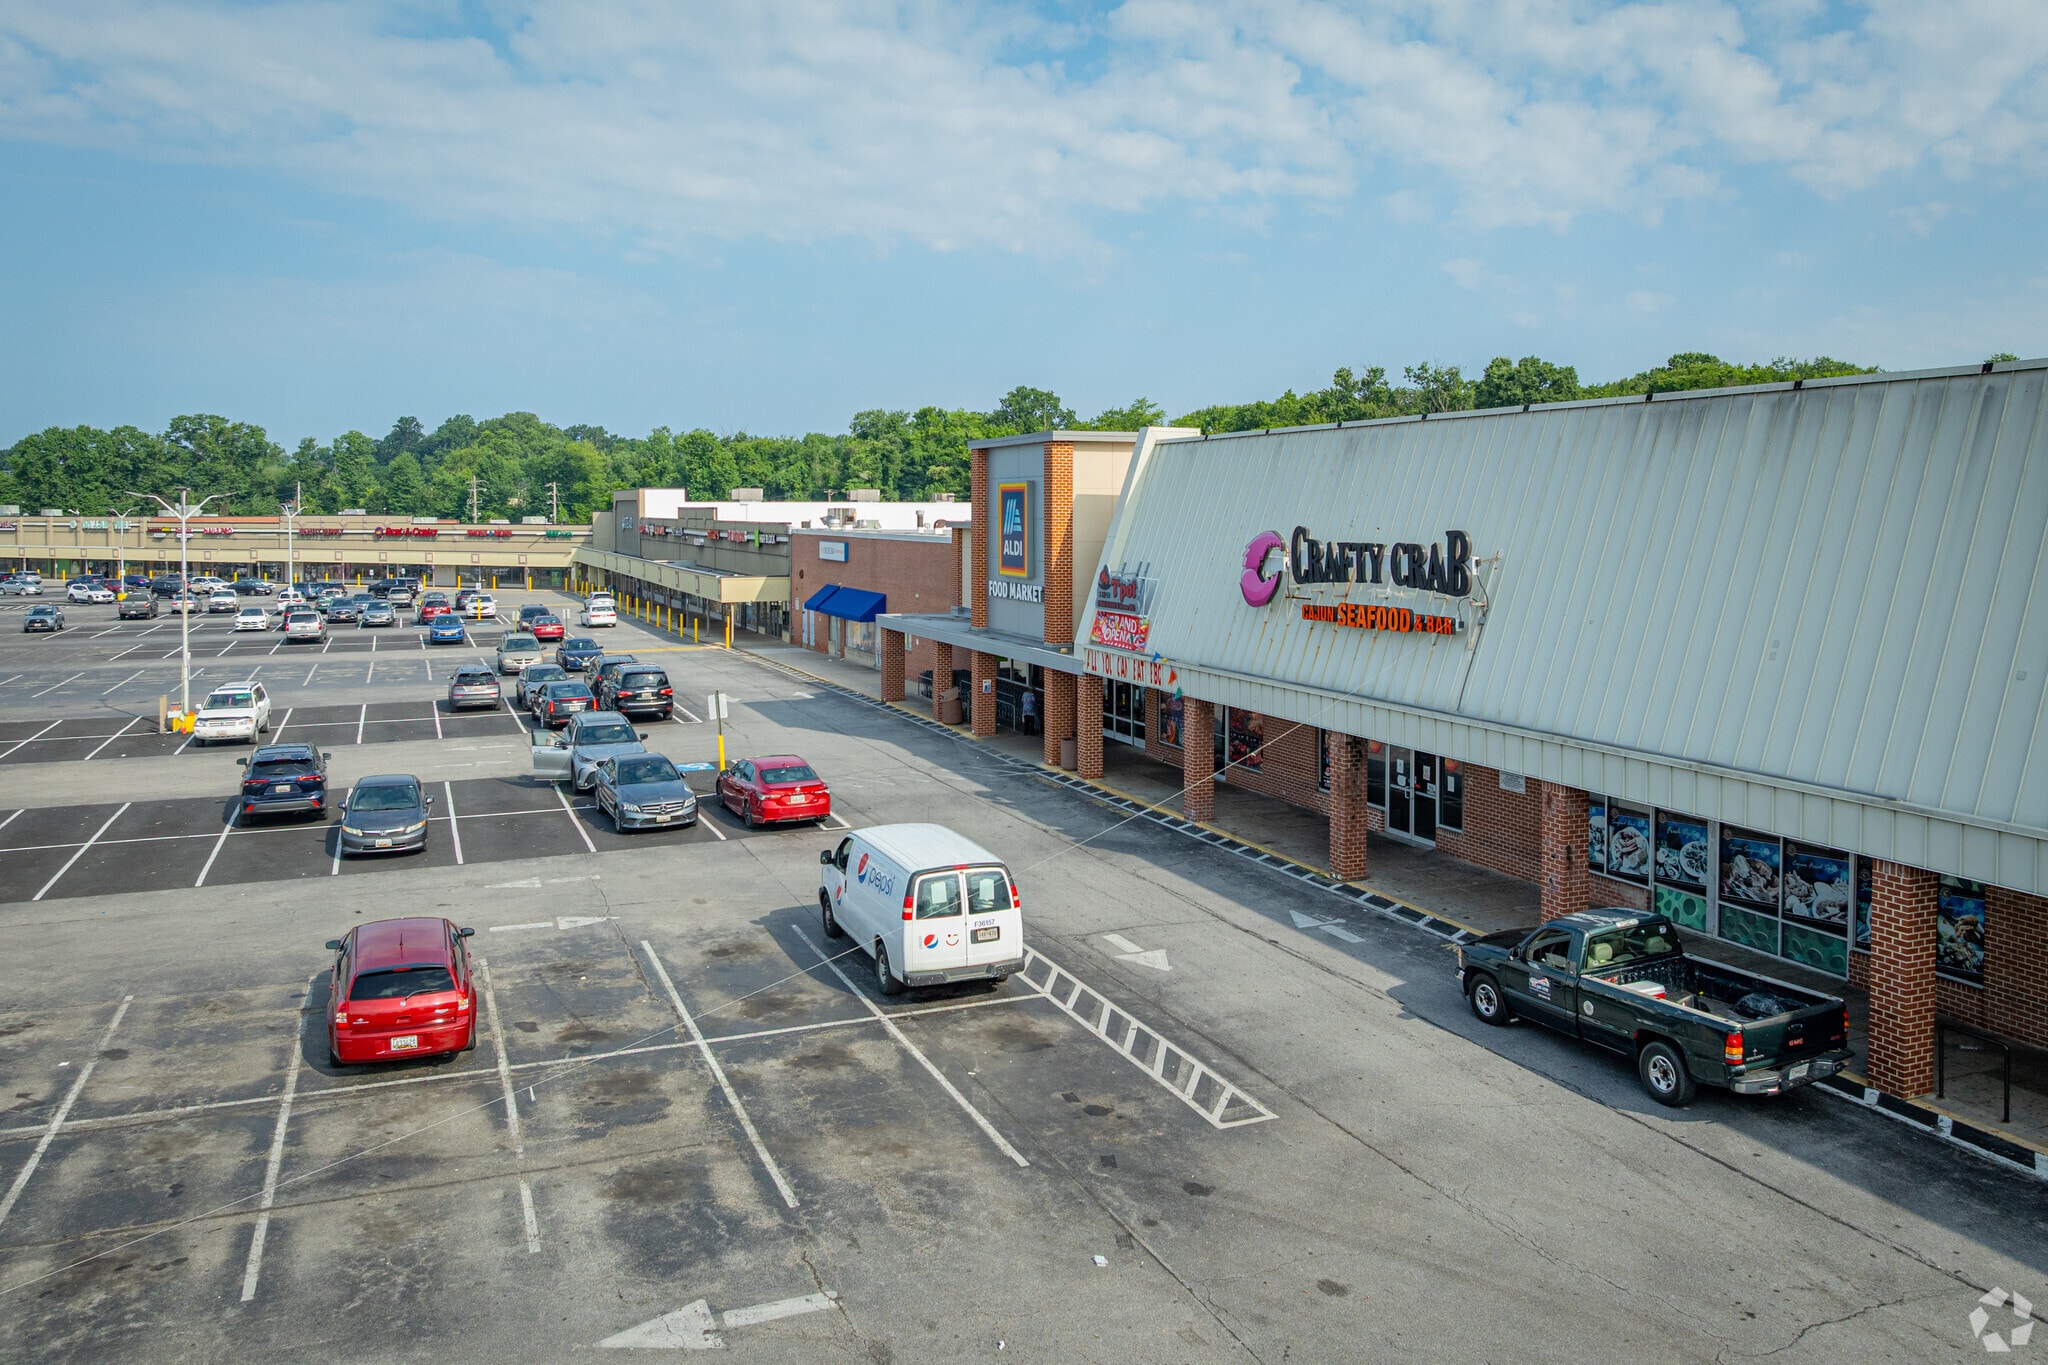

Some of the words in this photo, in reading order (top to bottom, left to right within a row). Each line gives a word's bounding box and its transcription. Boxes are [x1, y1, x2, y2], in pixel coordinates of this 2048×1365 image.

[1003, 540, 1022, 556] ALDI
[1291, 525, 1386, 585] CRAFTY
[1390, 529, 1472, 597] CRAB
[988, 581, 1008, 598] FOOD
[1009, 584, 1042, 603] MARKET
[1108, 615, 1137, 633] GRAND
[1301, 604, 1335, 623] CAJUN
[1336, 602, 1412, 634] SEAFOOD
[1414, 615, 1424, 632] &
[1426, 616, 1453, 635] BAR
[867, 867, 896, 897] pepsi
